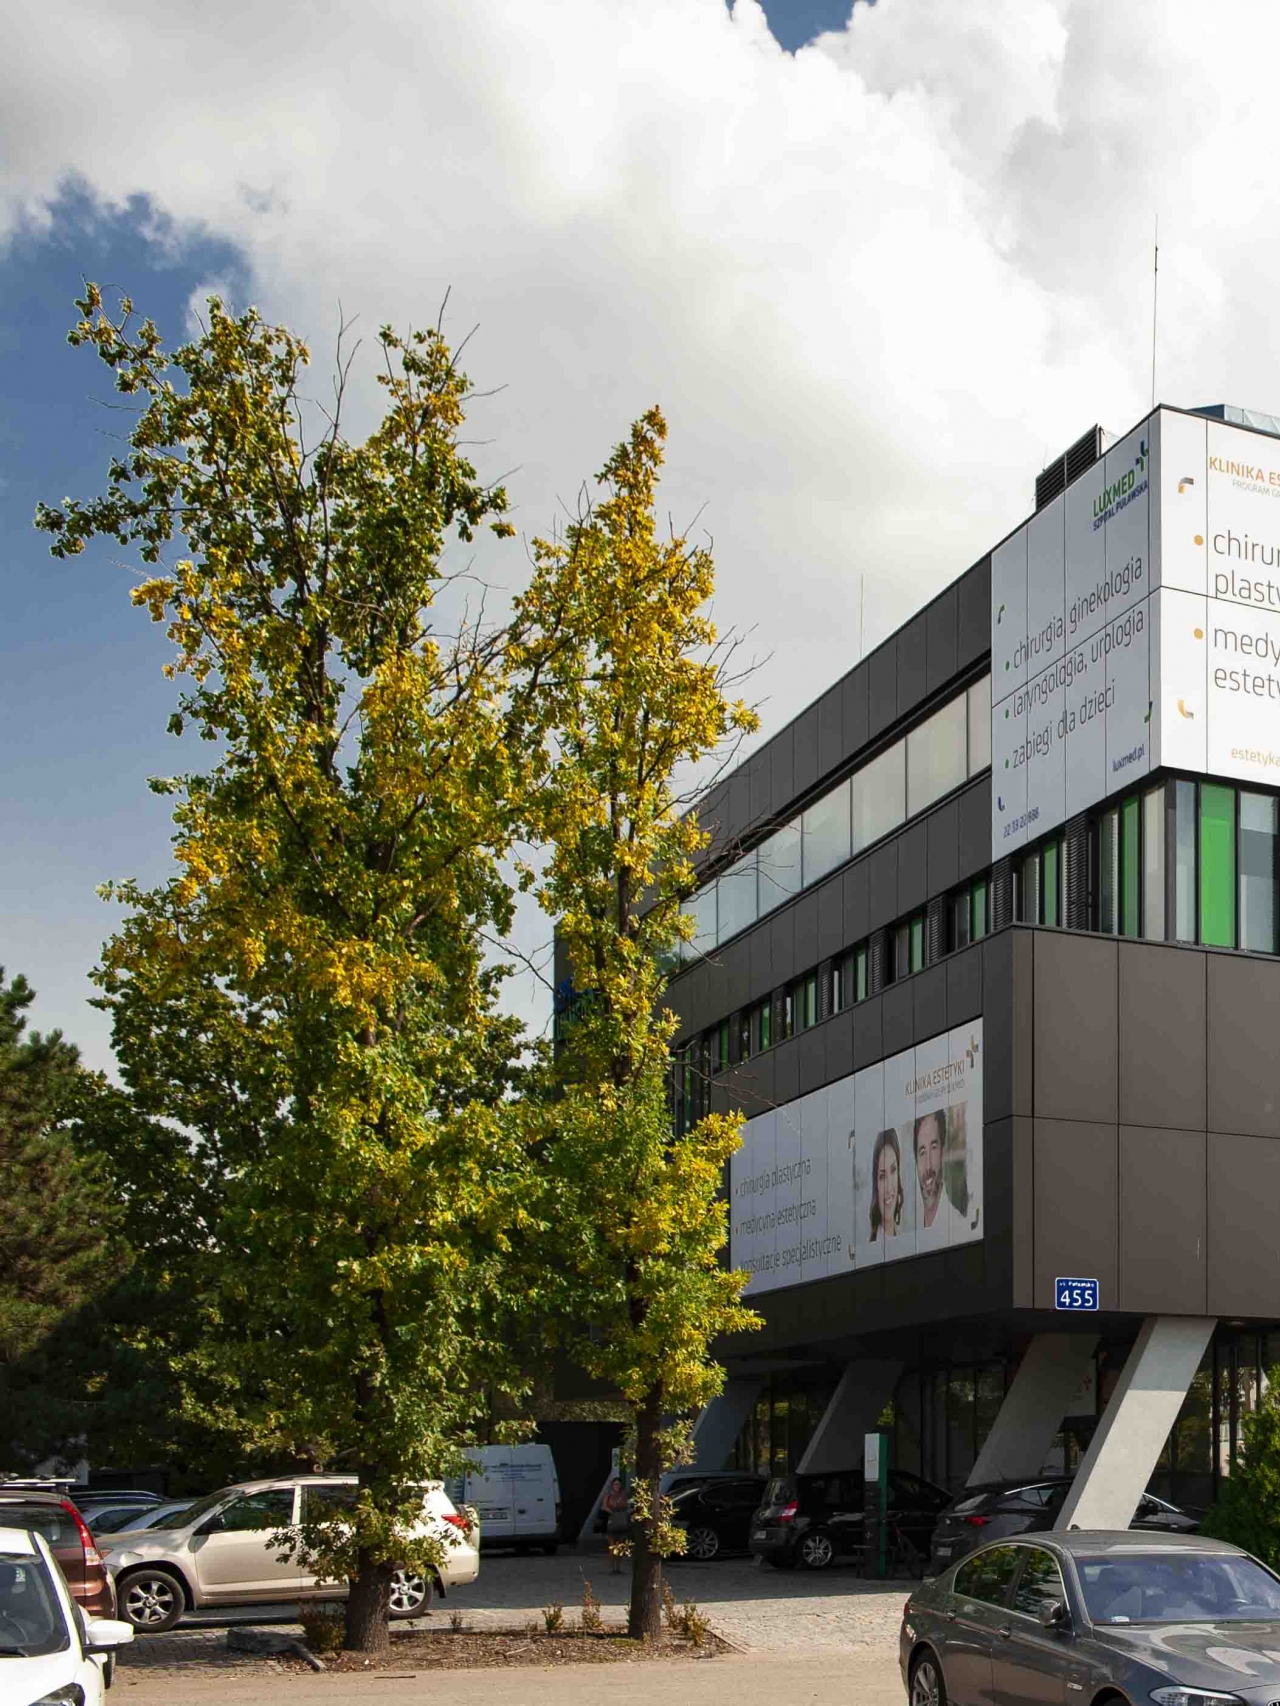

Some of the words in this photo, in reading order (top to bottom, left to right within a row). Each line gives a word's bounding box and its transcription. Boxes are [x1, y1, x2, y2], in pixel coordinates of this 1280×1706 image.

[1209, 456, 1265, 482] KLINIKA
[1093, 469, 1135, 518] LUXMED
[1093, 505, 1116, 531] SZPITAL
[1069, 557, 1142, 634] ginekologia
[1013, 651, 1088, 718] laryngologia,
[1091, 610, 1144, 663] urologia
[1013, 721, 1053, 768] zabiegi
[1057, 709, 1076, 739] dla
[1079, 679, 1115, 725] dzieci
[1112, 744, 1145, 772] luxmed.pl
[905, 1074, 932, 1097] KLINIKA
[933, 1060, 965, 1085] ESTETYKI
[740, 1170, 770, 1196] chirurgia
[771, 1158, 811, 1191] plastyczna
[740, 1212, 776, 1236] medycyna
[777, 1199, 817, 1226] estetyczna
[781, 1235, 842, 1268] specjalistyczne
[1060, 1290, 1094, 1307] 455
